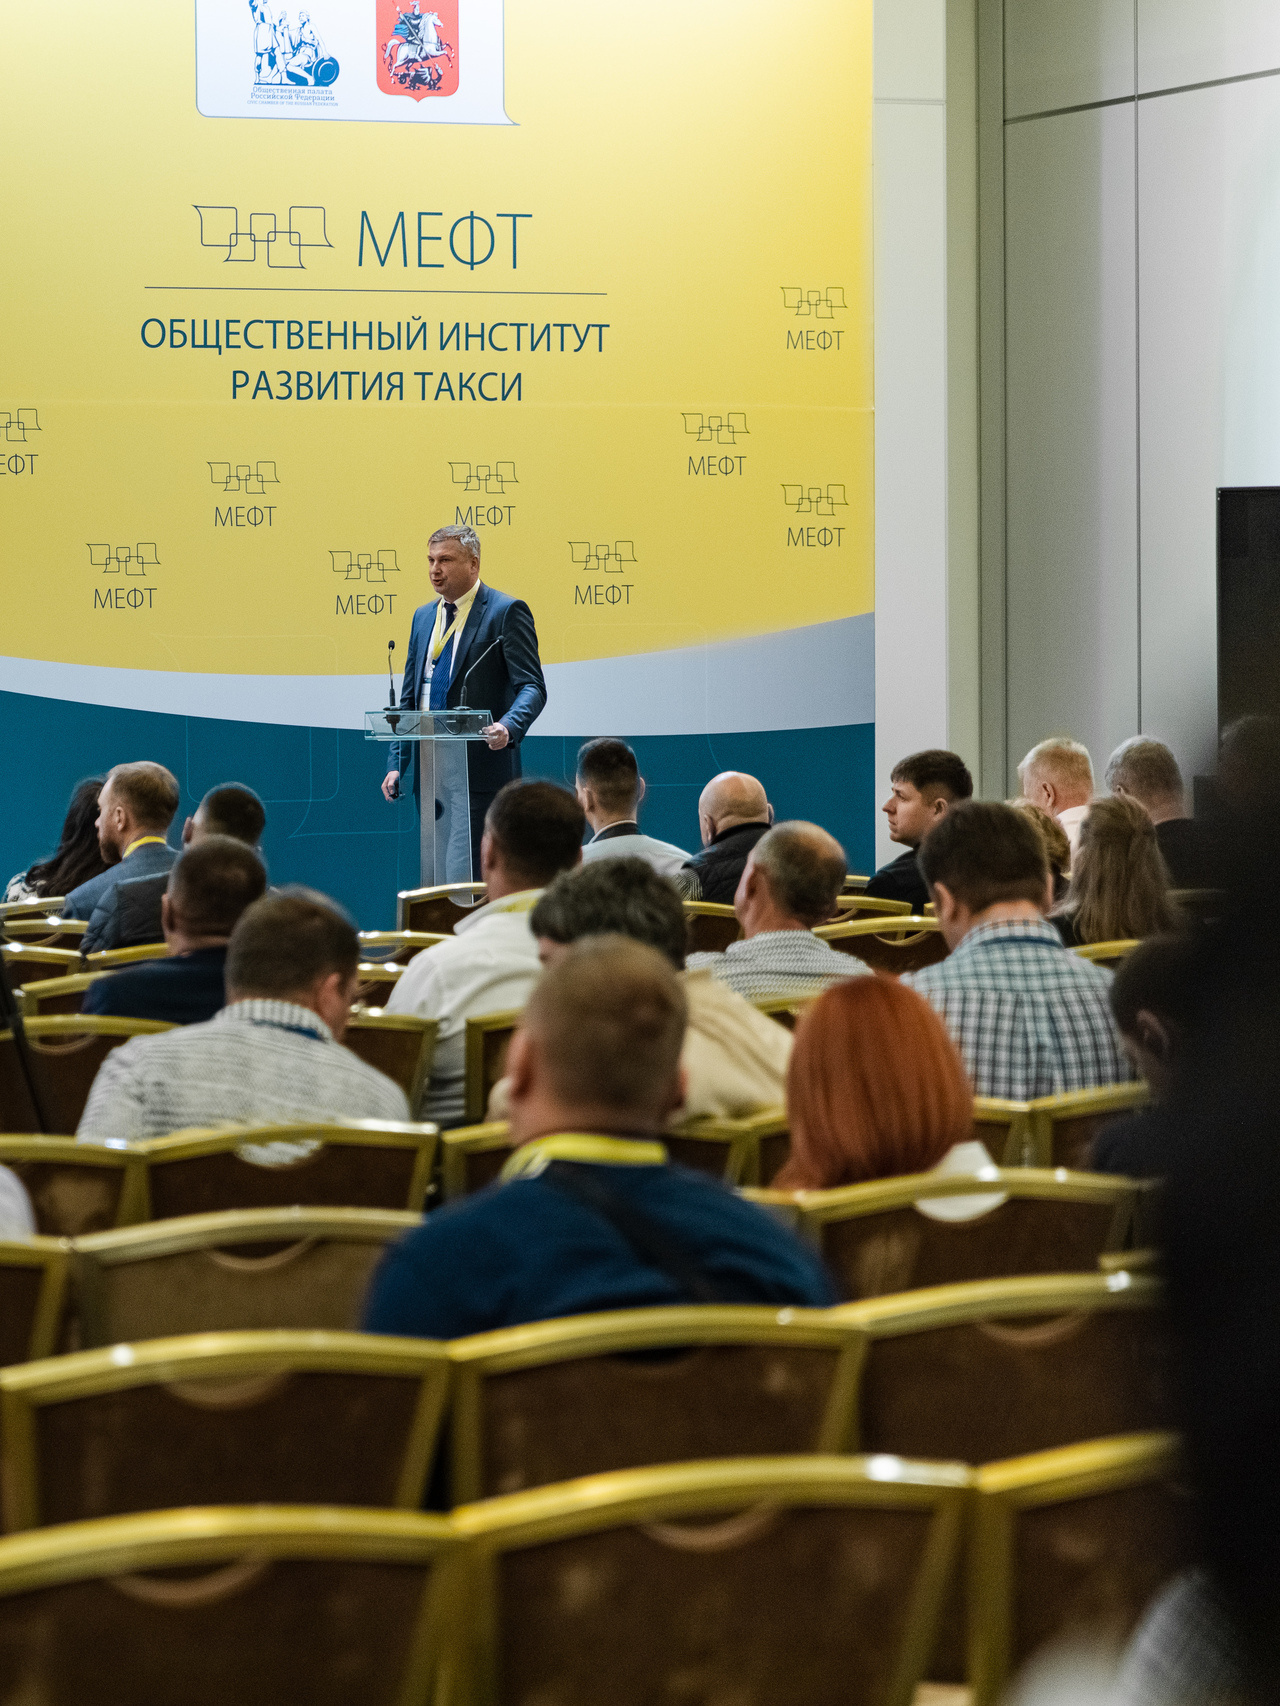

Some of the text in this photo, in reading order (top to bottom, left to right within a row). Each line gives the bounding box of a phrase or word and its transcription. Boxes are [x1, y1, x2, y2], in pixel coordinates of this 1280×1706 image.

[357, 210, 534, 272] МЕФТ
[140, 315, 611, 356] ОБЩЕСТВЕННЫЙ ИНСТИТУТ
[786, 329, 845, 352] МЕФТ
[231, 369, 522, 402] РАЗВИТИЯ ТАКСИ
[687, 455, 748, 477] МЕФТ
[214, 505, 278, 528] МЕФТ
[454, 504, 517, 527] МЕФТ
[786, 526, 846, 548] МЕФТ
[93, 587, 158, 610] МЕФТ
[335, 593, 398, 616] МЕФТ
[574, 583, 635, 606] МЕФТ
